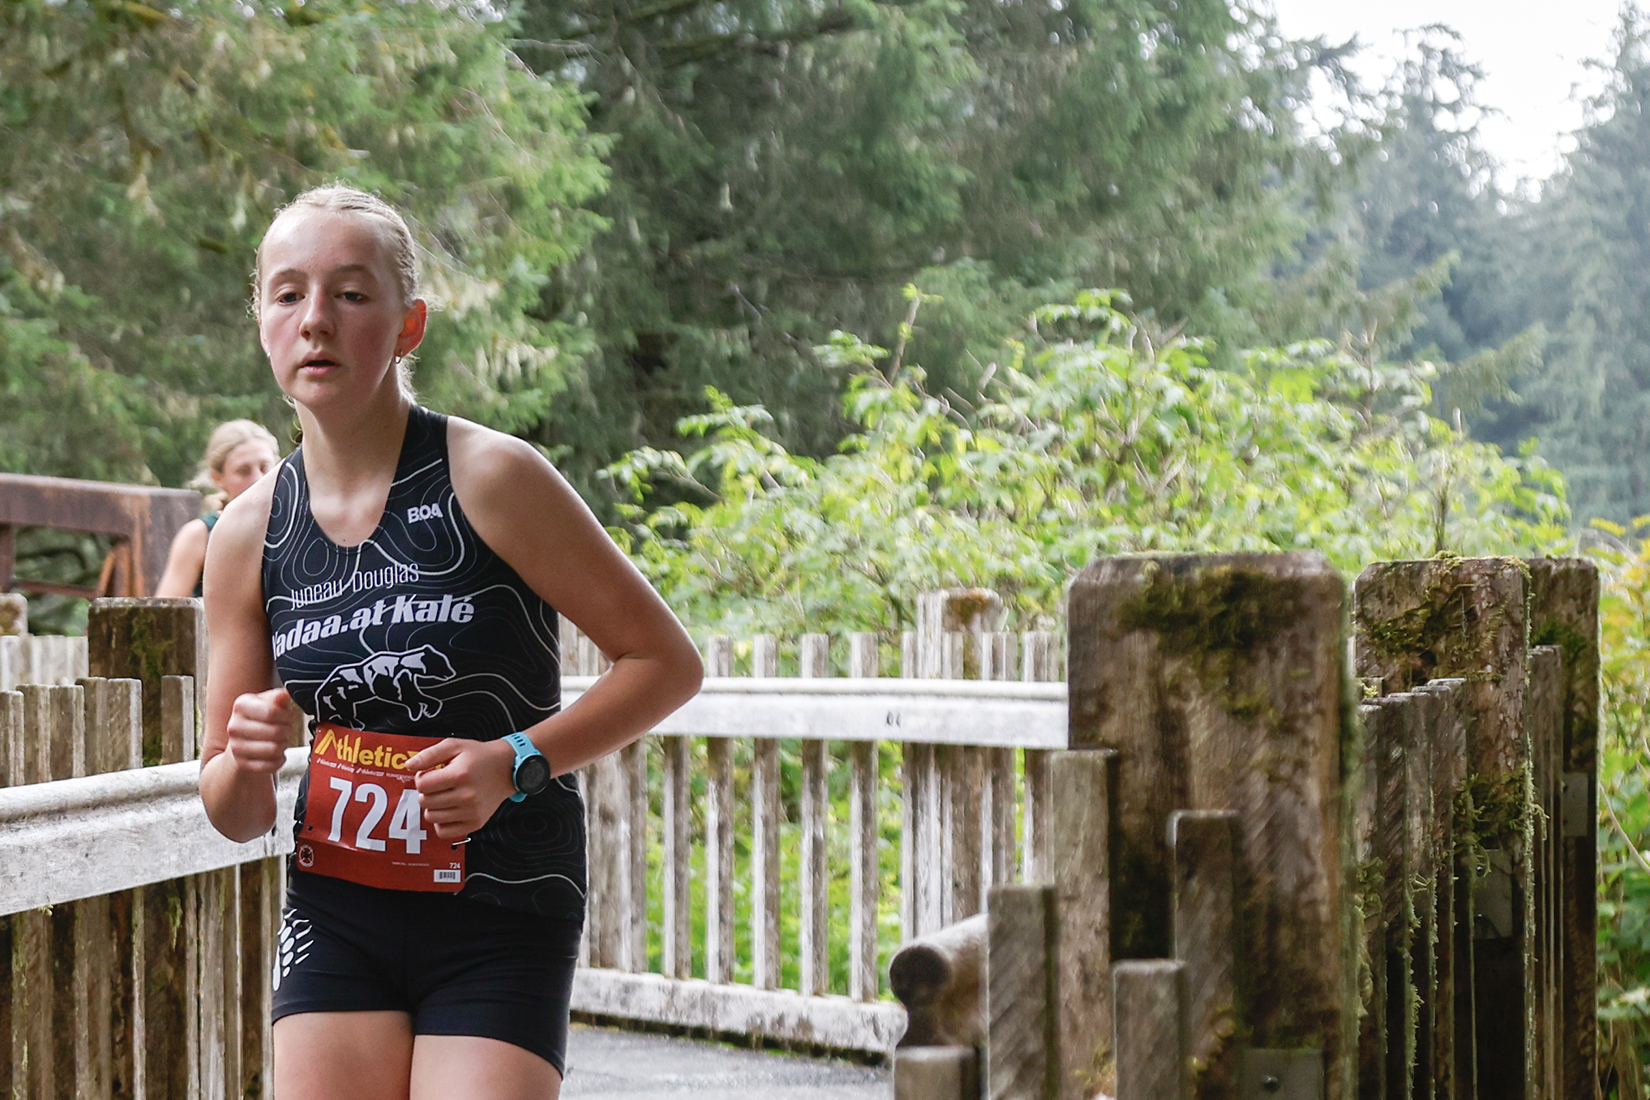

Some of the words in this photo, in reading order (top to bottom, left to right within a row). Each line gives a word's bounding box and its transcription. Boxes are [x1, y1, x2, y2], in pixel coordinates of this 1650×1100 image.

[352, 562, 420, 593] Douglas
[390, 593, 475, 623] Kalé
[327, 776, 428, 855] 724
